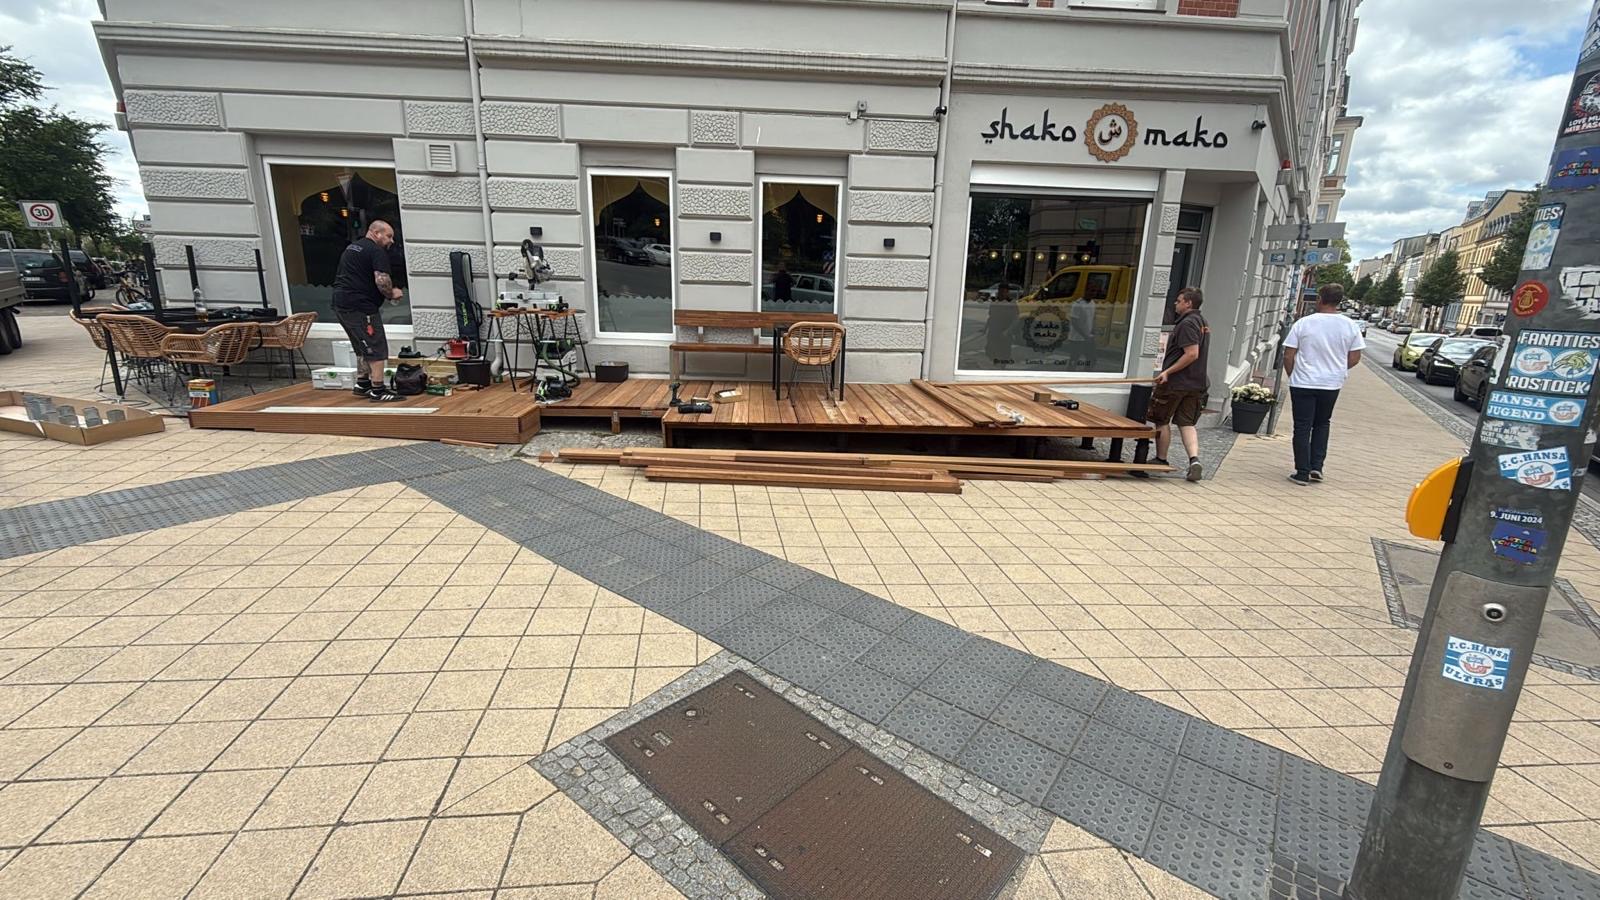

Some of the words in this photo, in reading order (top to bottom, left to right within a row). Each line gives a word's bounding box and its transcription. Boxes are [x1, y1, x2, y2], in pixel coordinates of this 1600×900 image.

[981, 107, 1076, 144] shako
[1144, 115, 1228, 148] mako
[34, 208, 49, 217] 30
[1520, 332, 1600, 349] FANATICS
[1507, 375, 1585, 394] ROSTOCK
[1491, 393, 1547, 408] HANSA
[1487, 405, 1545, 420] JUGEND
[1500, 512, 1520, 521] JUNI
[1445, 666, 1502, 687] ULTRAS
